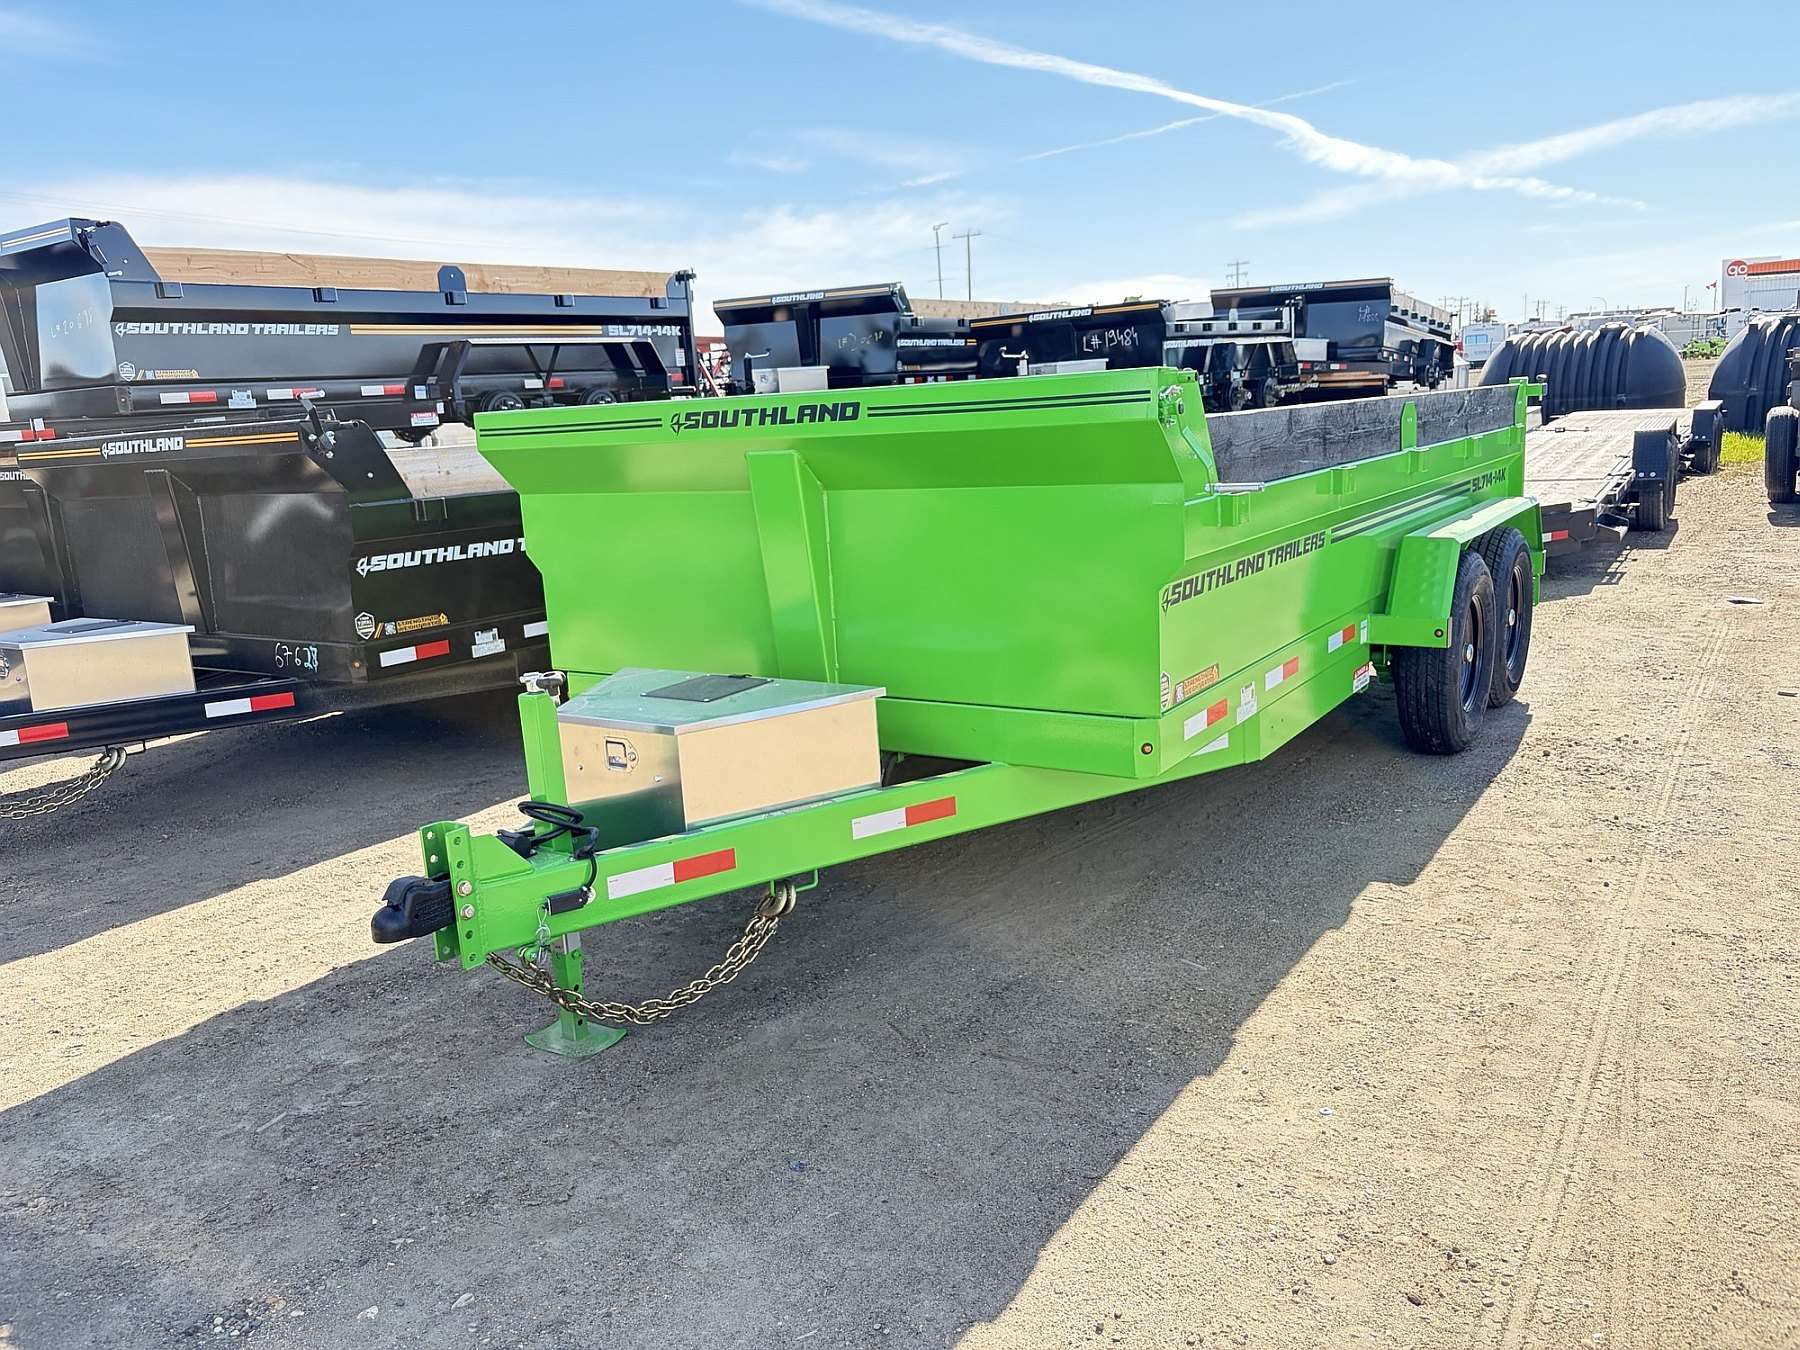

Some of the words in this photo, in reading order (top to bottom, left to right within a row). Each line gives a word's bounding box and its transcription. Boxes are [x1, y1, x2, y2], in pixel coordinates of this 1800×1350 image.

[1033, 308, 1092, 320] SOUTHLAND
[126, 322, 249, 335] SOUTHLAND
[252, 324, 340, 335] TRAILERS
[608, 325, 682, 336] SL714-14K
[683, 401, 861, 430] SOUTHLAND
[107, 436, 184, 455] SOUTHLAND
[0, 471, 32, 480] SOUTHL
[369, 538, 516, 573] SOUTHLAND
[1170, 551, 1266, 606] SOUTHLAND
[1267, 530, 1327, 568] TRAILERS
